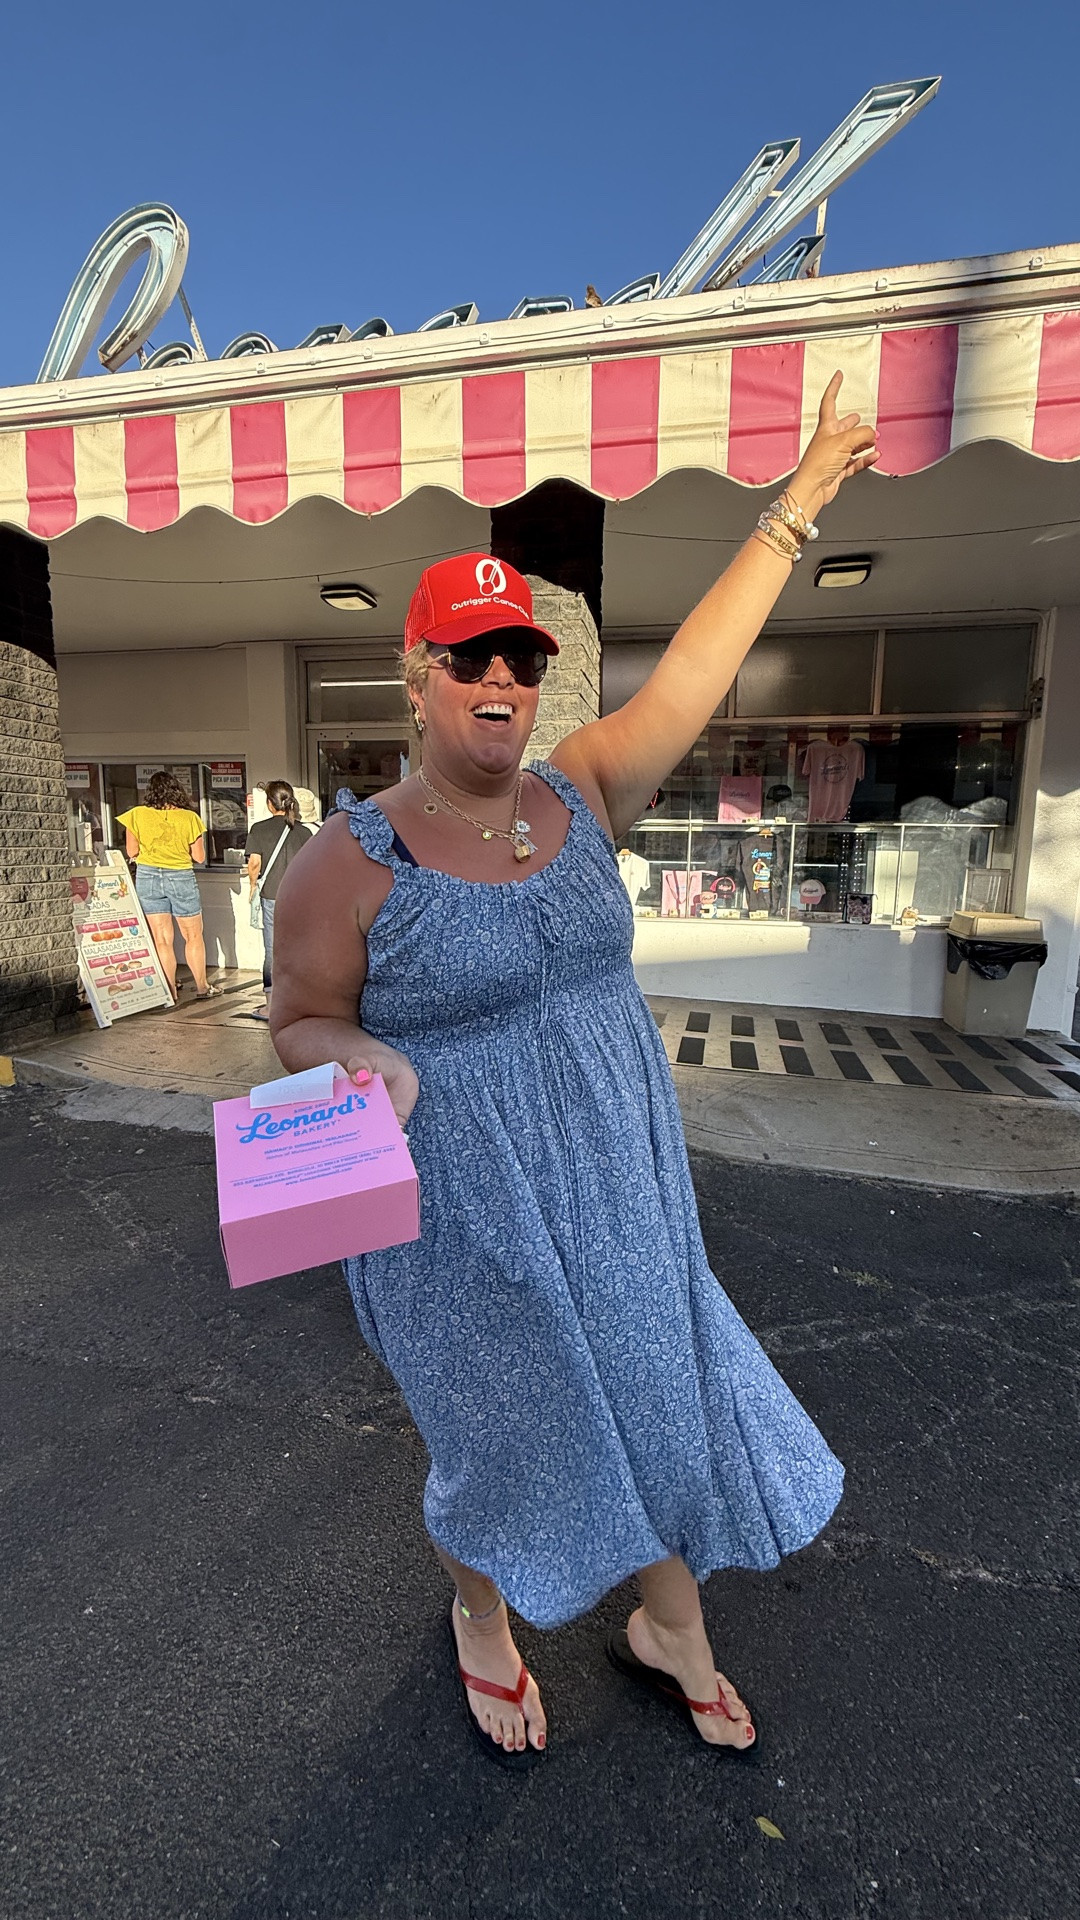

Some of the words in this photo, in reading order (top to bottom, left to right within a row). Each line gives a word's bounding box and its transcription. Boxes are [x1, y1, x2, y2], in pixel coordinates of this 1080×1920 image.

[451, 597, 492, 611] Outrigger
[83, 942, 122, 955] MALASADAS
[123, 940, 142, 948] PUFFS
[235, 1094, 367, 1144] Leonard's
[294, 1121, 336, 1137] BAKERY
